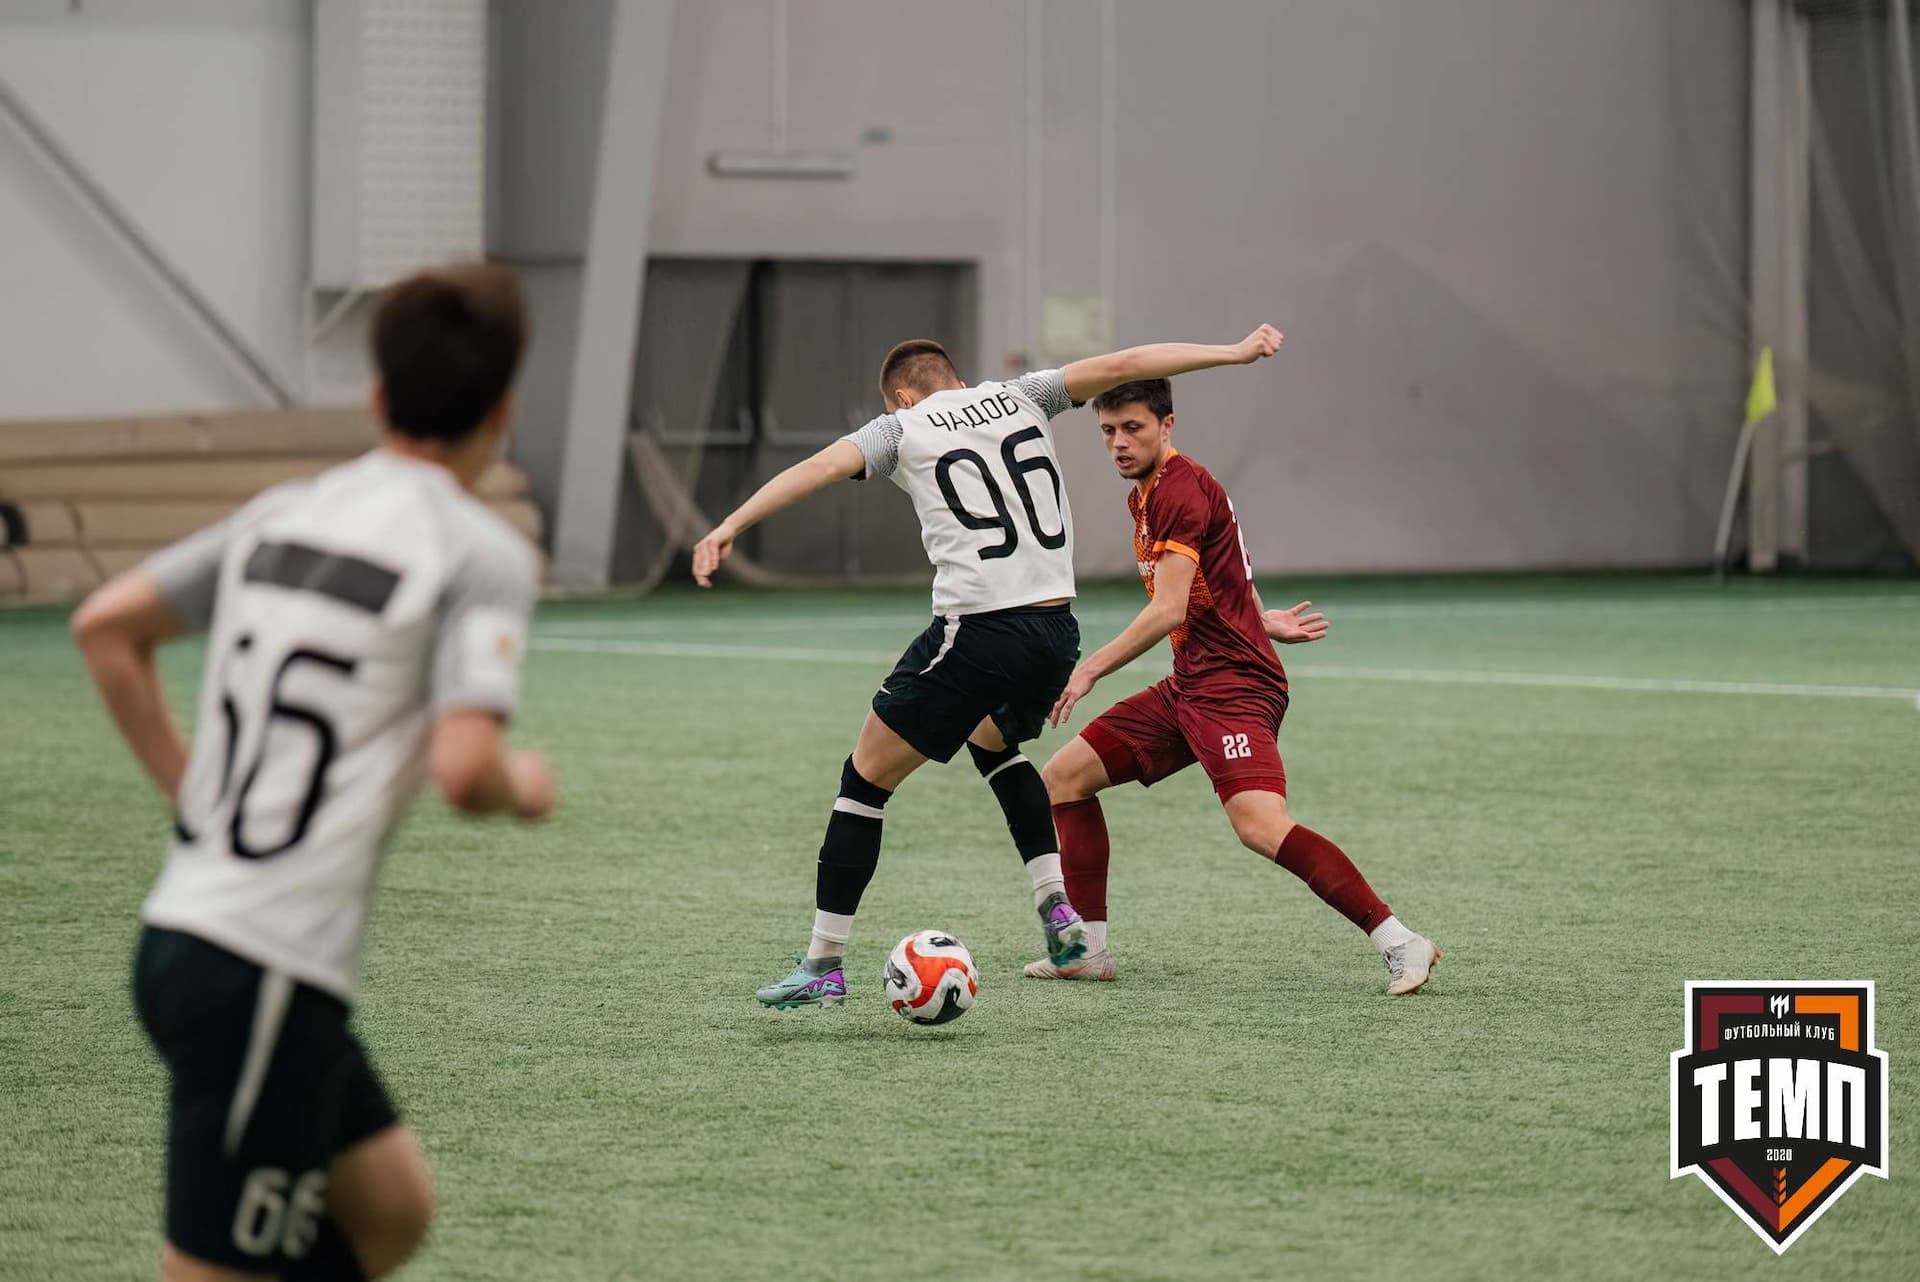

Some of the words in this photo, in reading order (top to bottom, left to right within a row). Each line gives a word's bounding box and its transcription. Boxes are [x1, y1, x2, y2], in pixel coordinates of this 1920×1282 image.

[935, 425, 1066, 560] 96
[1221, 733, 1252, 760] 22
[231, 1166, 328, 1259] 66
